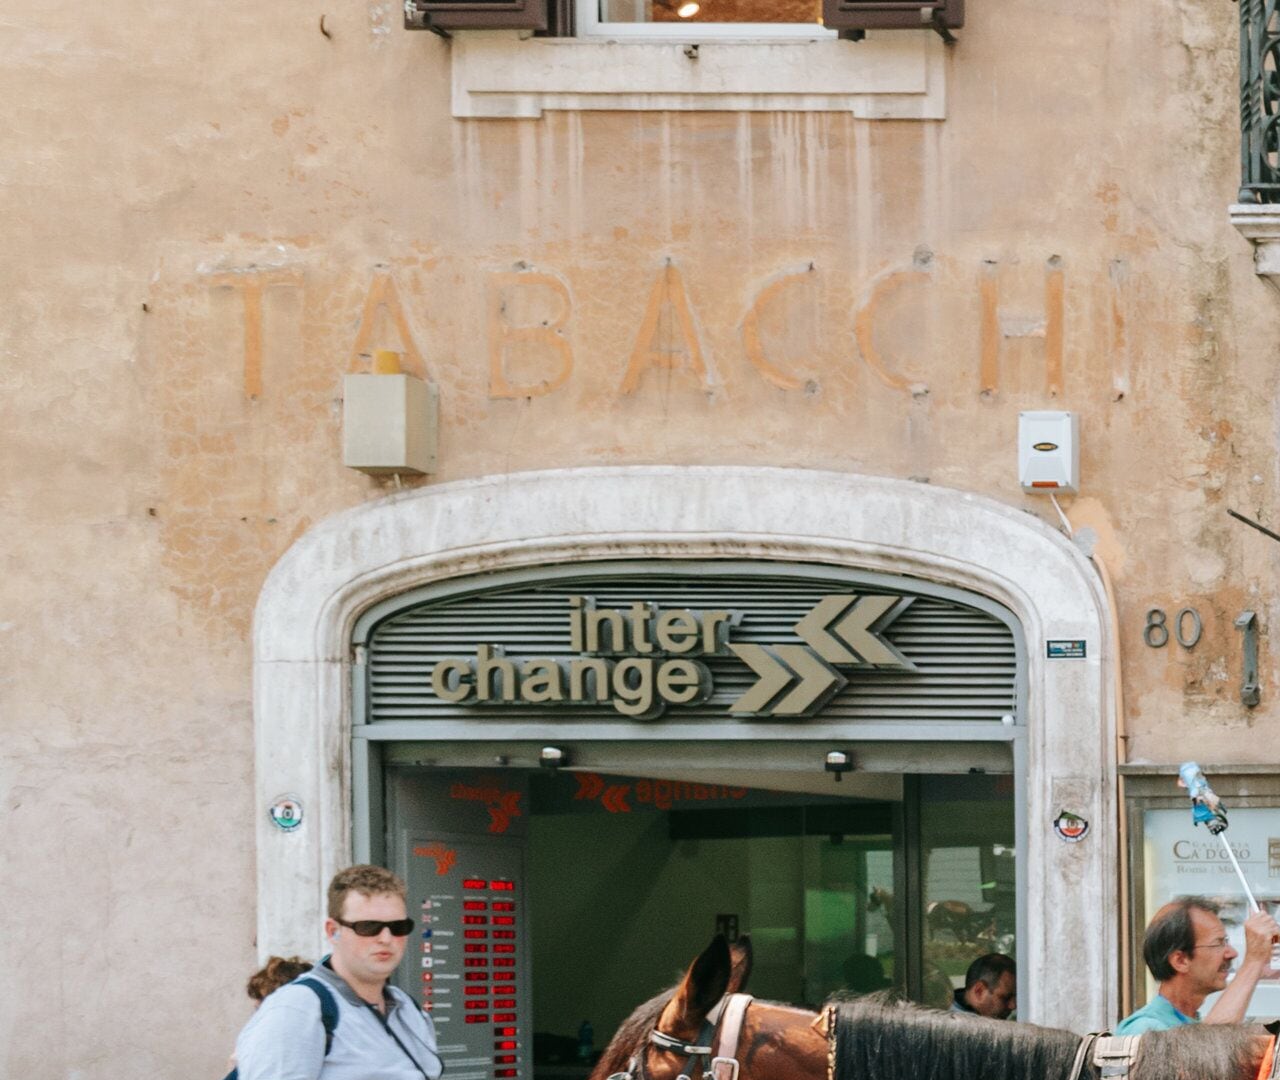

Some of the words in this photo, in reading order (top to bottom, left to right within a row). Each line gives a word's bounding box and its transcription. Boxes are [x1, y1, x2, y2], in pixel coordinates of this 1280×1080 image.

[569, 595, 733, 655] inter
[1142, 606, 1203, 649] 80
[429, 644, 704, 717] change
